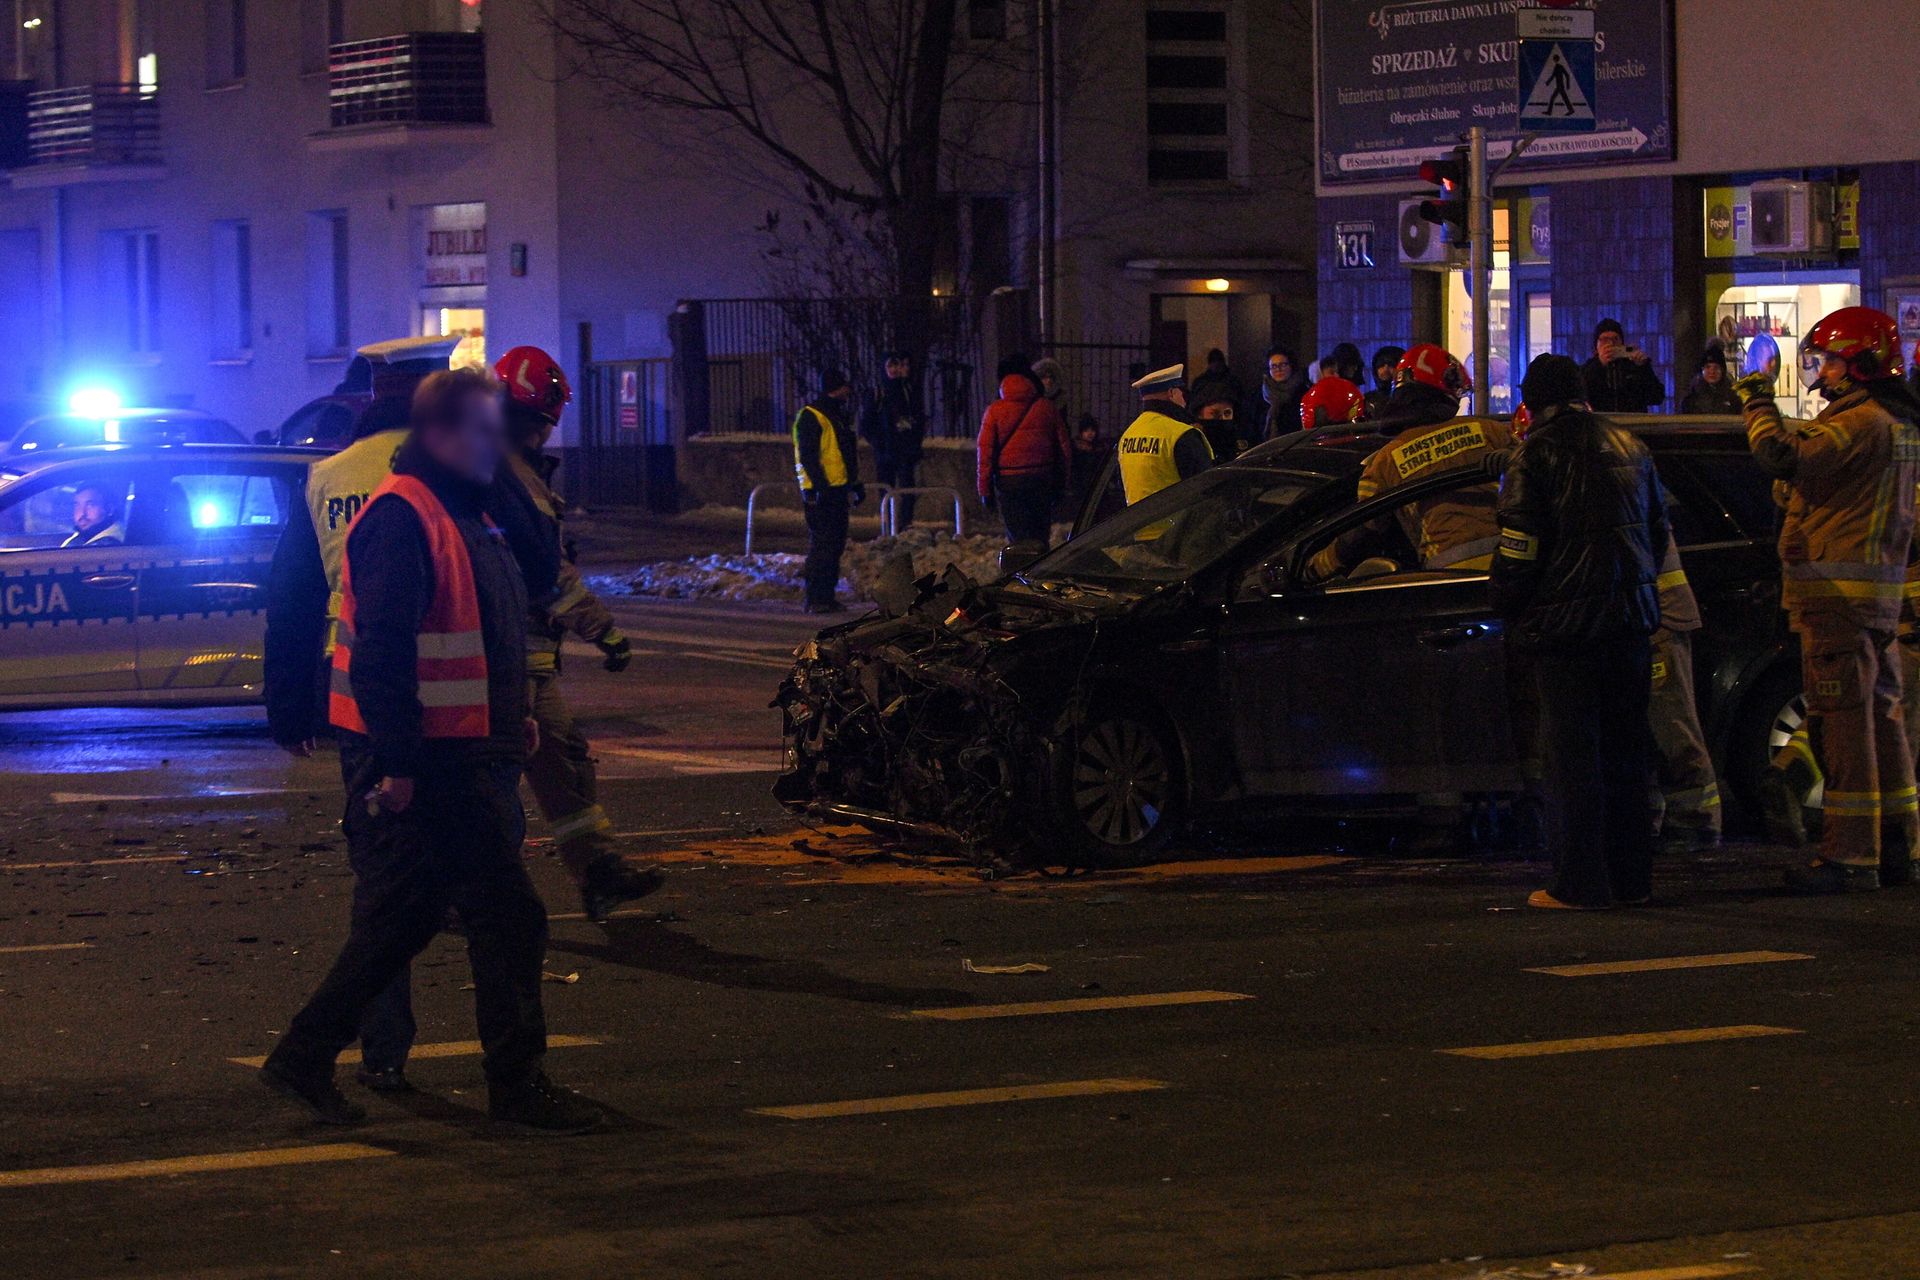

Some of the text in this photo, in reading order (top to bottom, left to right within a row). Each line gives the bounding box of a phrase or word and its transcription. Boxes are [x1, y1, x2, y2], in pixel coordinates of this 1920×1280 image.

[1394, 8, 1449, 26] BIŻUTERIA
[1450, 5, 1492, 21] DAWNA
[1372, 43, 1457, 75] SPRZEDAŻ
[1469, 78, 1494, 93] oraz
[1472, 103, 1496, 118] Skup
[1339, 233, 1368, 267] 131
[1122, 437, 1159, 454] POLICJA
[328, 493, 369, 529] PO
